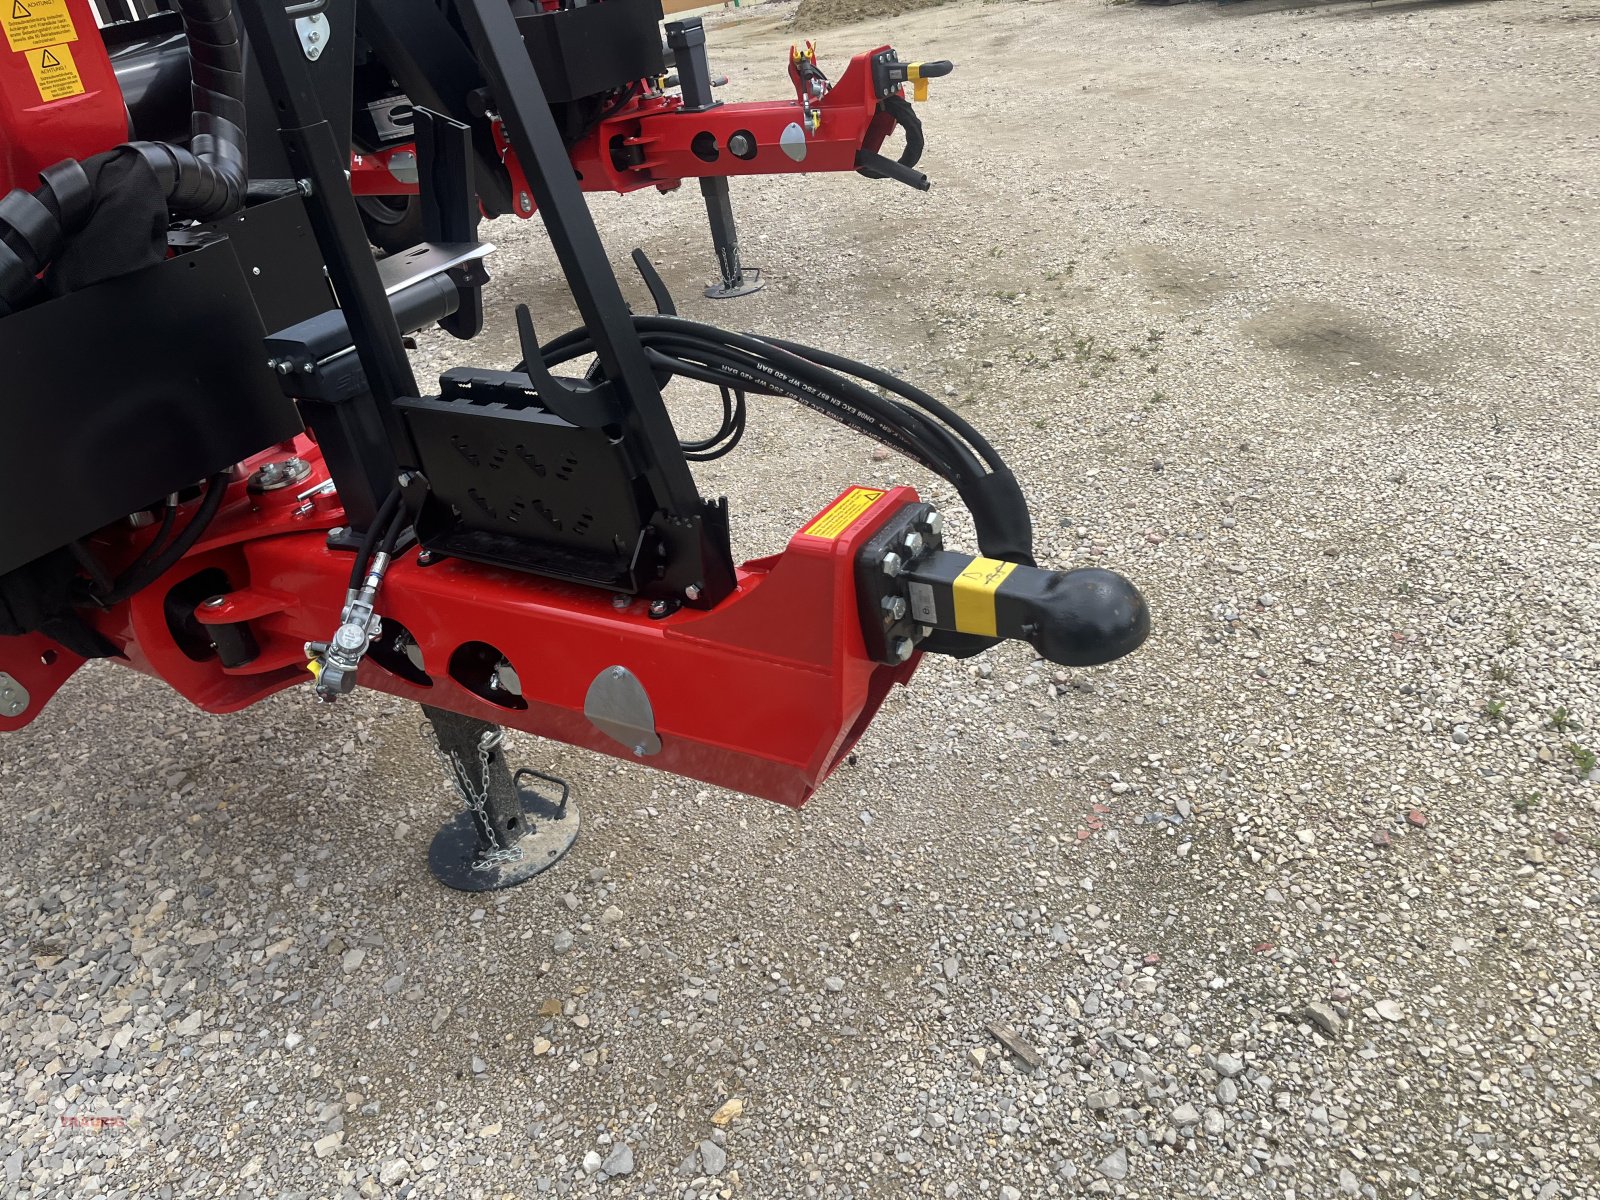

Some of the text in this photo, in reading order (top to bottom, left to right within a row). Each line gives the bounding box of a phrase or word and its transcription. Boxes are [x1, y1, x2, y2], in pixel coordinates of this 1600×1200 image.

[41, 66, 65, 74] ACHTUNG
[354, 155, 362, 165] 4
[721, 364, 738, 375] BAR
[756, 362, 774, 375] BAR
[740, 371, 753, 380] 420
[774, 370, 787, 380] 420
[754, 378, 767, 387] WP
[788, 379, 800, 387] WP
[769, 383, 783, 393] 2SC
[801, 384, 816, 394] 2SC
[819, 392, 830, 400] 857
[830, 397, 841, 406] EN
[841, 403, 857, 415] EXC
[857, 411, 875, 423] DN08
